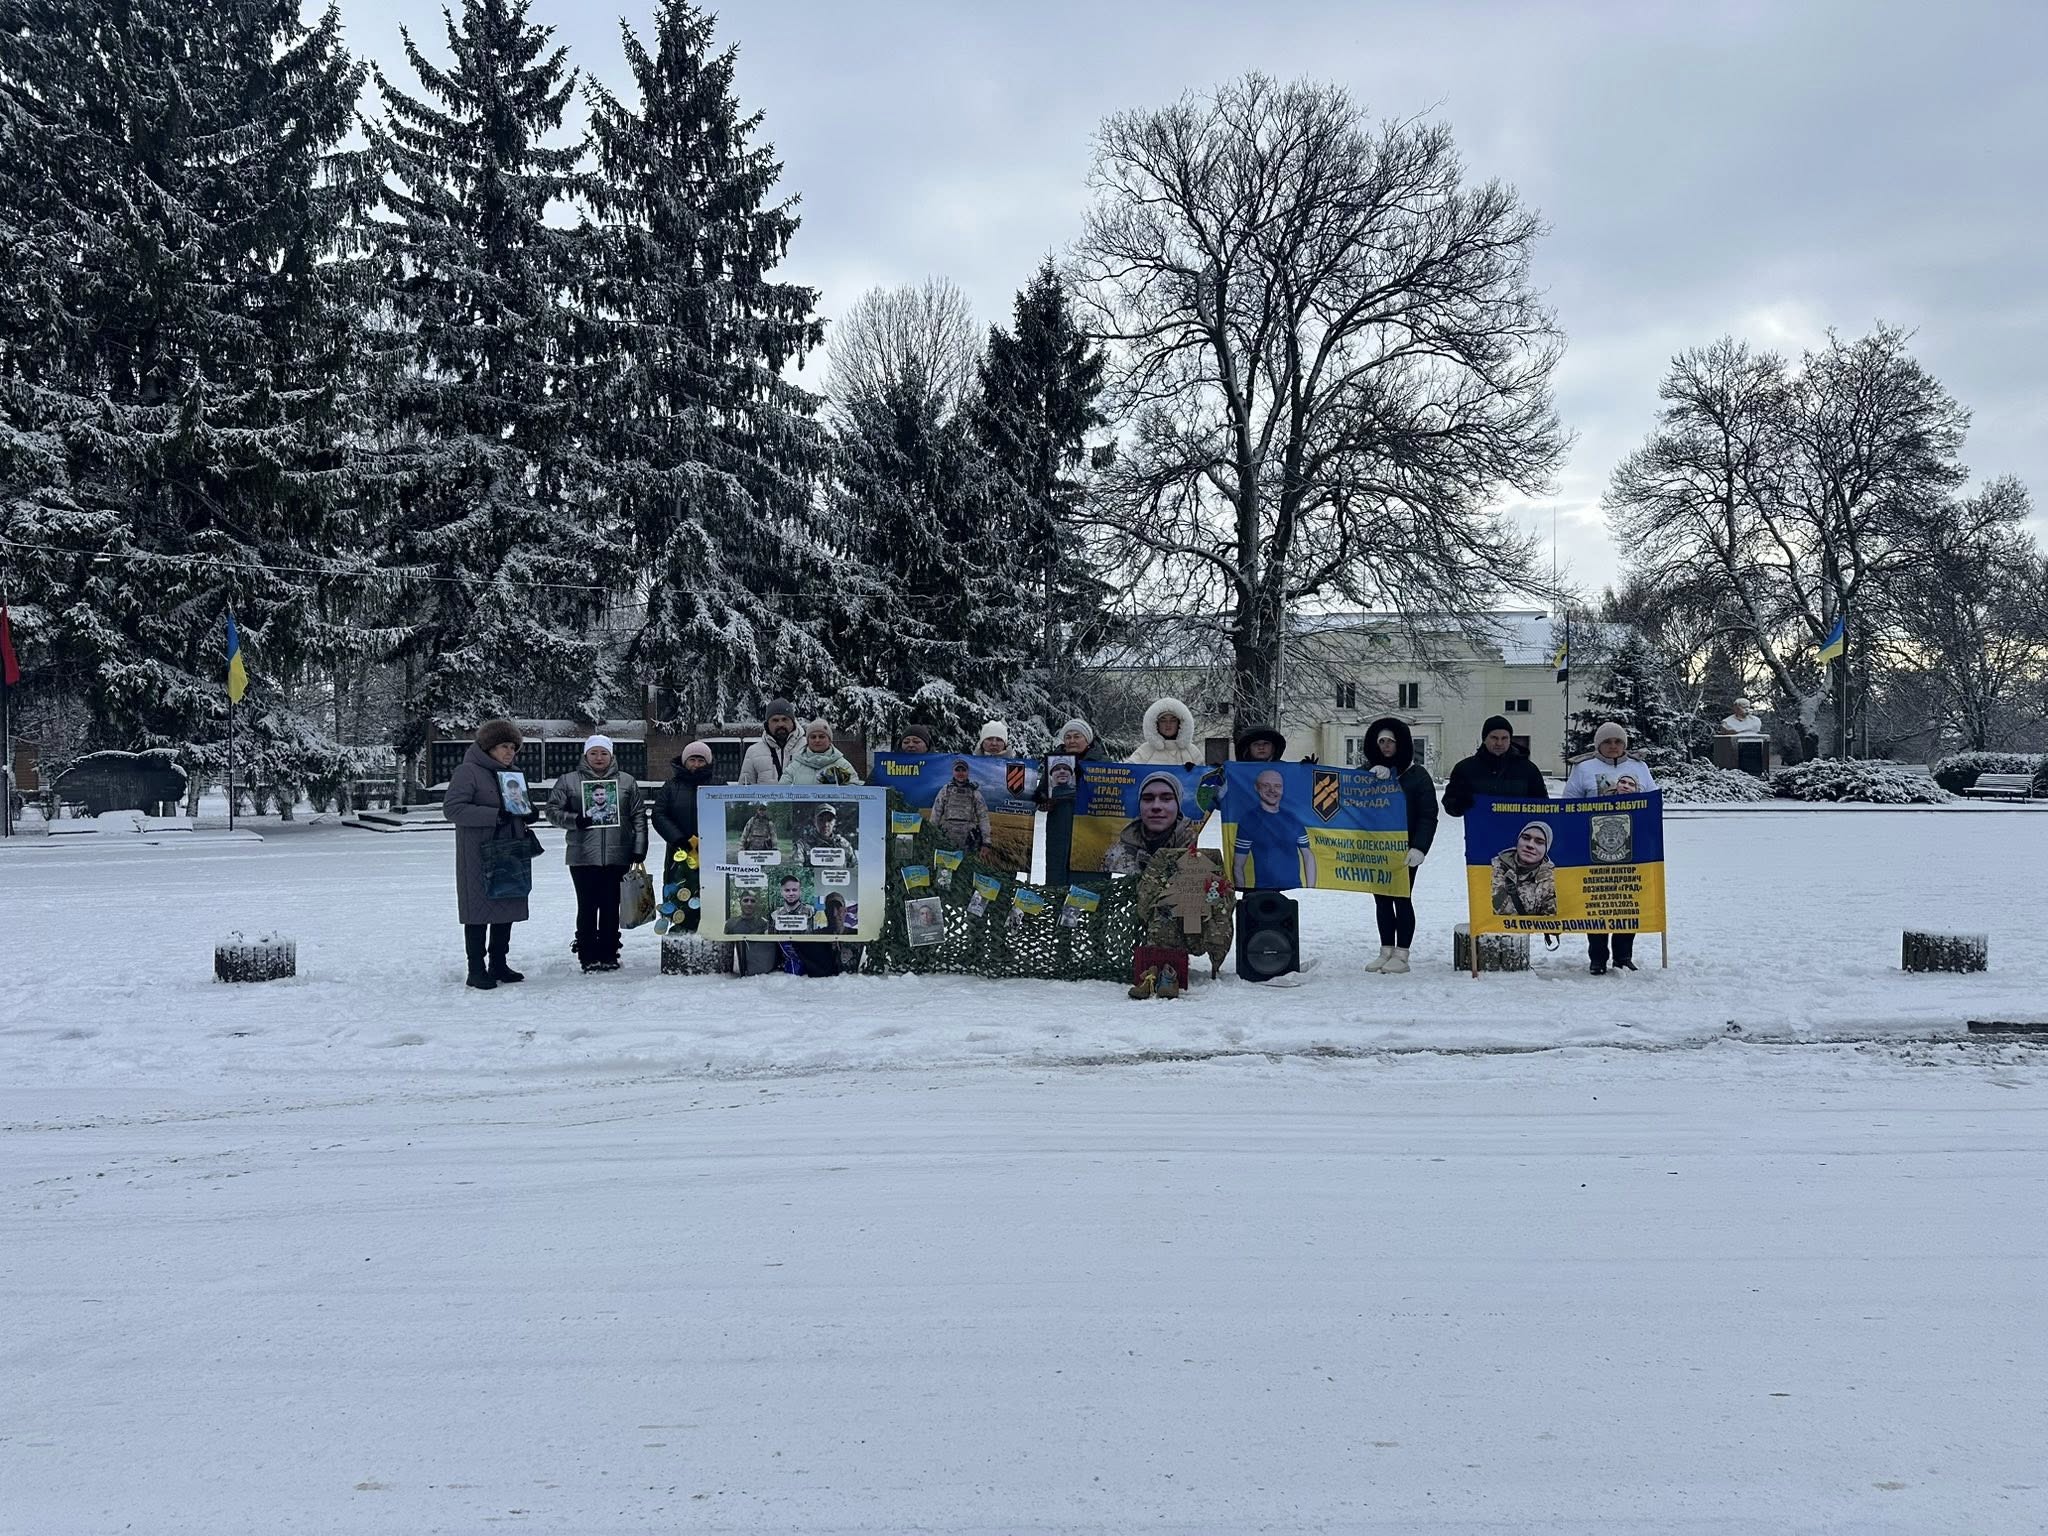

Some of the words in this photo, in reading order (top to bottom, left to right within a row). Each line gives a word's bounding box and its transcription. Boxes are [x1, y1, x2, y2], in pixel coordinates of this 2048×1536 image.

[1344, 784, 1403, 797] ШТУРМОВА
[1344, 798, 1390, 808] БРИГАДА
[1491, 803, 1521, 812] ЗНИКЛІ
[1521, 803, 1560, 813] БЕЗВІСТИ
[1565, 803, 1576, 813] НЕ
[1576, 801, 1614, 812] ЗНАЧИТЬ
[1615, 800, 1648, 810] ЗАБУТІ!
[1315, 836, 1355, 849] КНИЖНИК
[1356, 840, 1409, 851] ОЛЕКСАНДР
[1336, 852, 1388, 864] АНДРІЙОВИЧ
[1335, 866, 1392, 884] «КНИГА»
[1611, 866, 1636, 874] ВІКТОР
[1583, 875, 1641, 884] ОЛЕКСАНДРОВИЧ
[1583, 885, 1617, 893] ПОЗИВНИЙ
[1618, 884, 1642, 892] «ГРАД»
[1503, 919, 1517, 929] 94
[1519, 917, 1606, 931] ПРИКОРДОННИЙ
[1608, 918, 1639, 930] ЗАГІН
